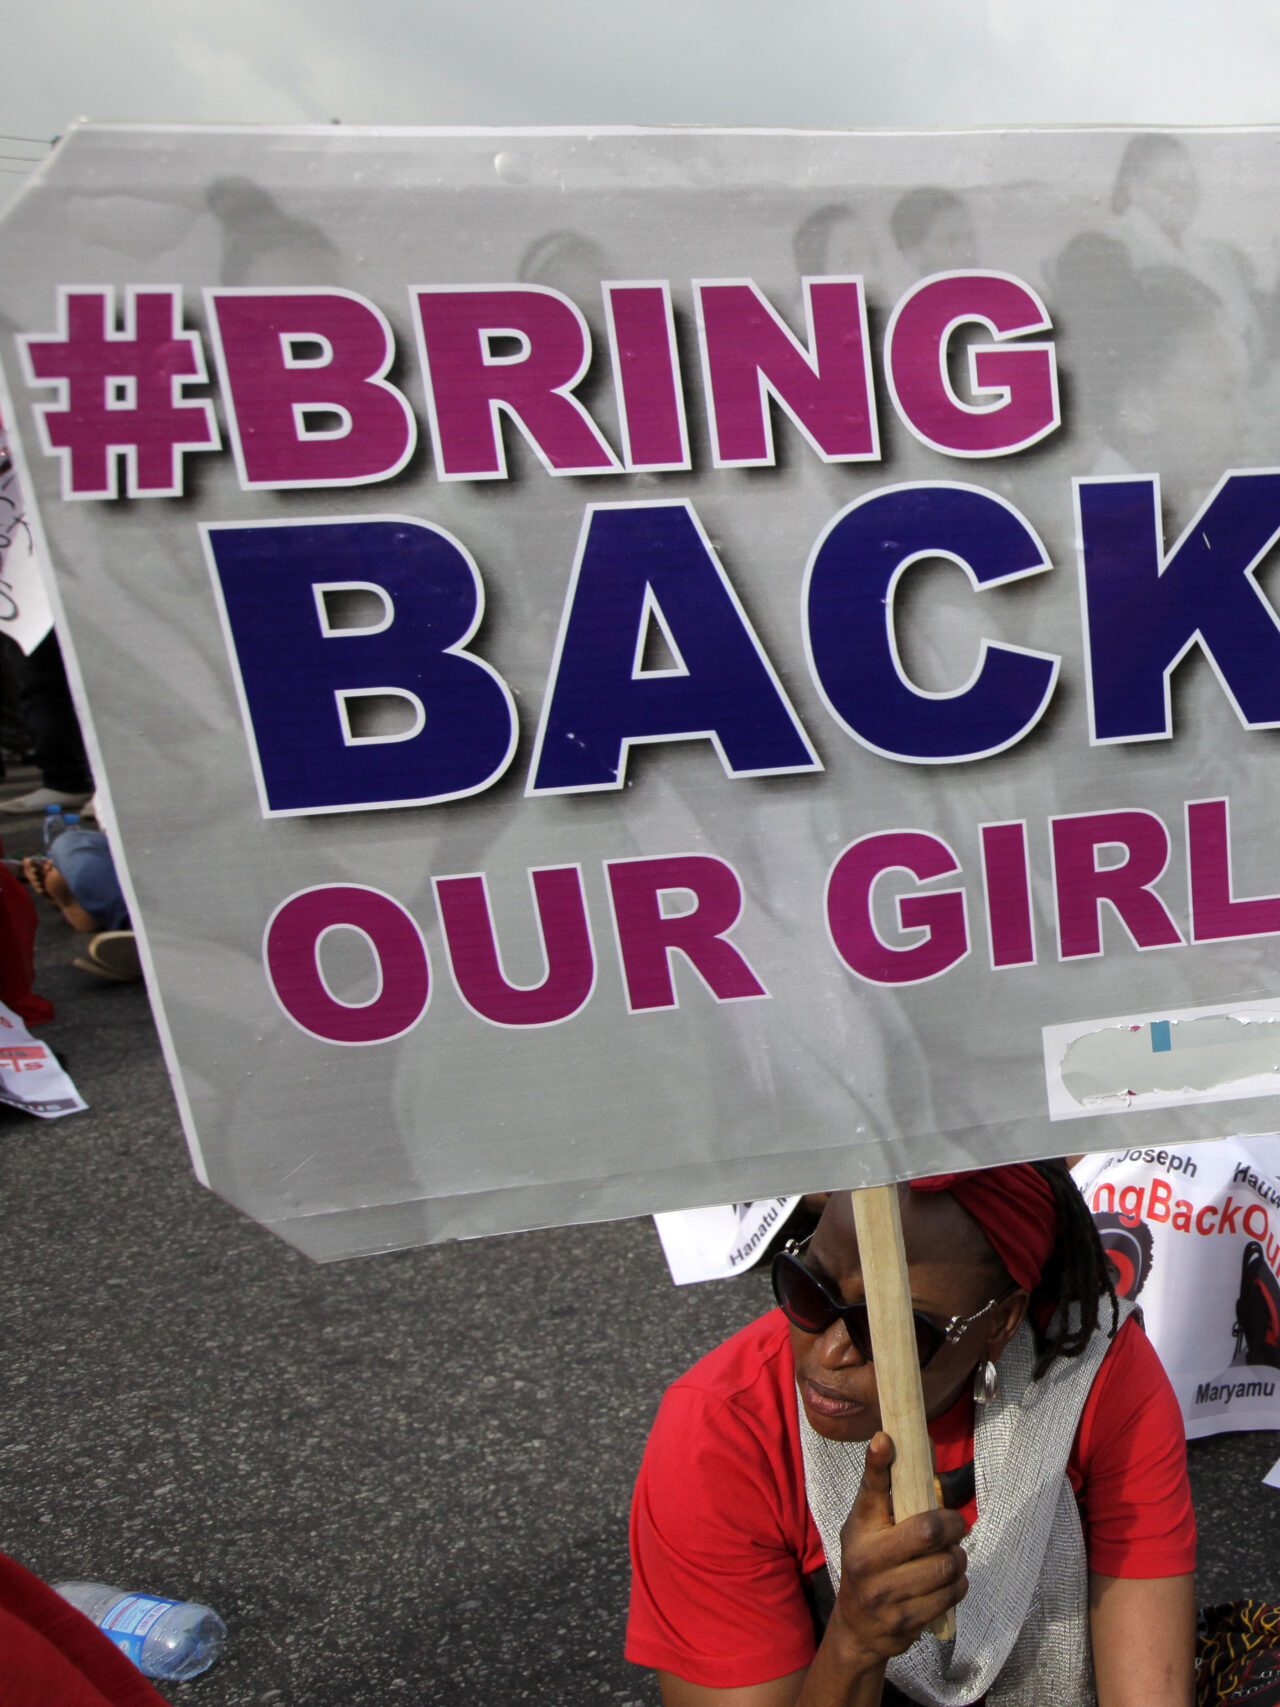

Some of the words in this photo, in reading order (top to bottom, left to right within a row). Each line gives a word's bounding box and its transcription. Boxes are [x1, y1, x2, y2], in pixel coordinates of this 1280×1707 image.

[19, 269, 1062, 501] #BRING
[264, 852, 770, 1045] OUR
[1117, 1148, 1198, 1178] Joseph
[730, 1207, 778, 1265] Hanatu
[1195, 1381, 1276, 1406] Maryamu
